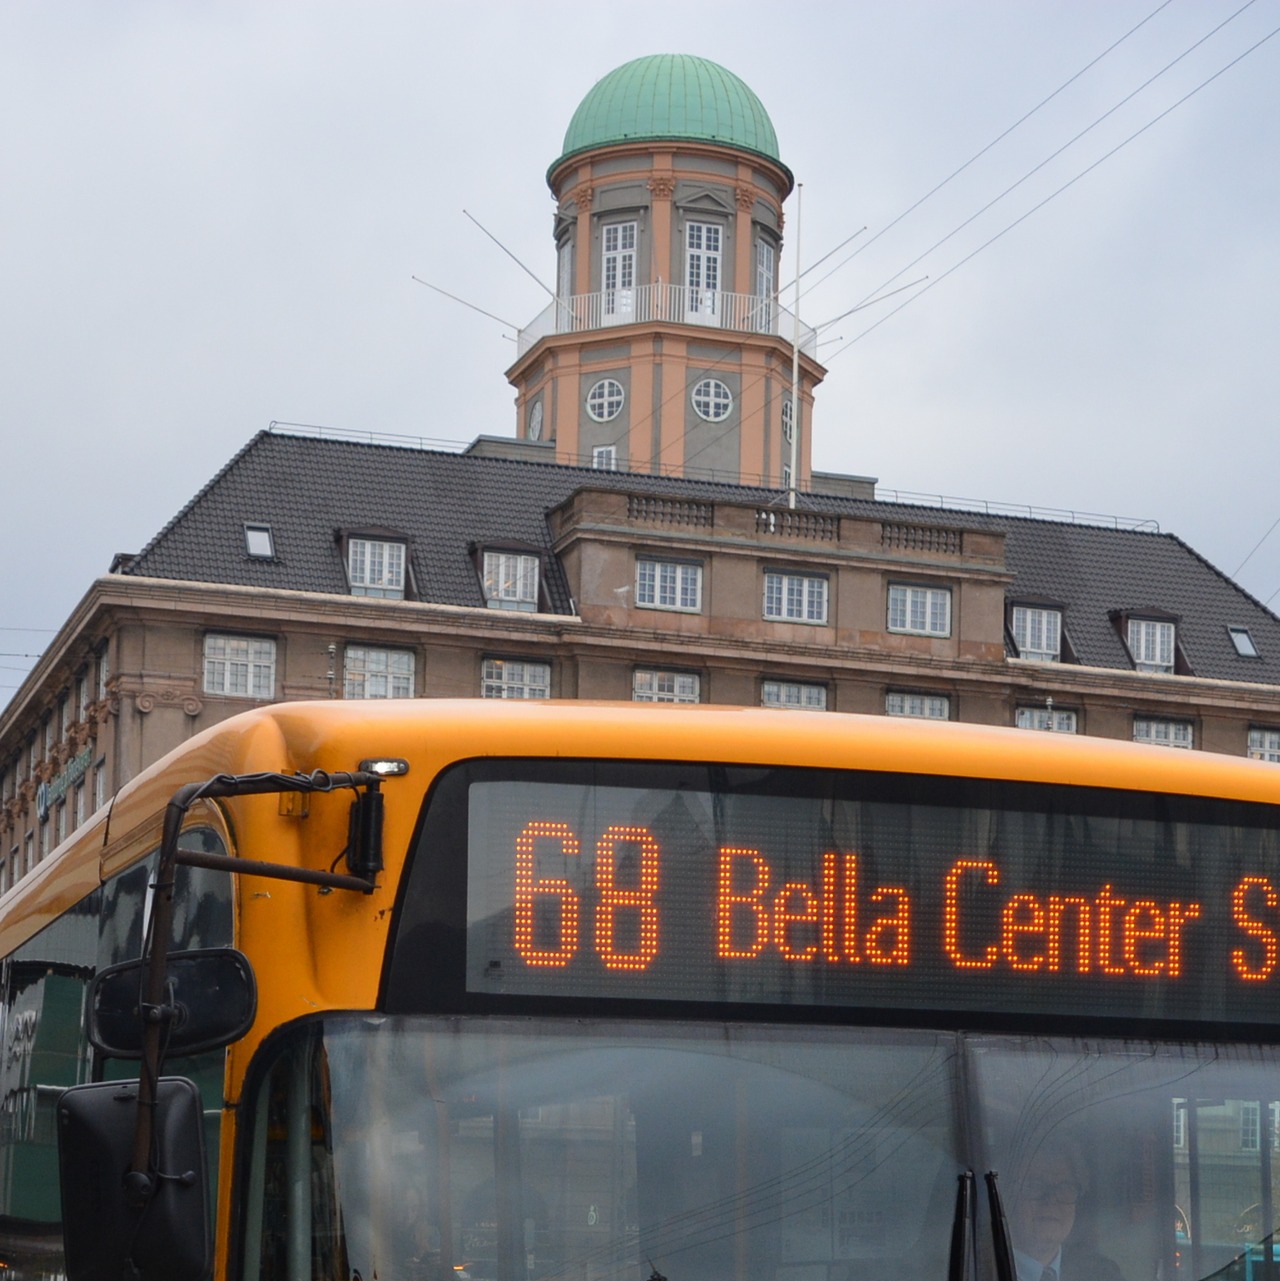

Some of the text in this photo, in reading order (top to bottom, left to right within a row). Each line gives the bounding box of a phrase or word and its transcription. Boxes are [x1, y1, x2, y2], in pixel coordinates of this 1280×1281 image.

[515, 822, 659, 970] 68
[717, 847, 910, 966] Bella
[944, 860, 1200, 977] Center
